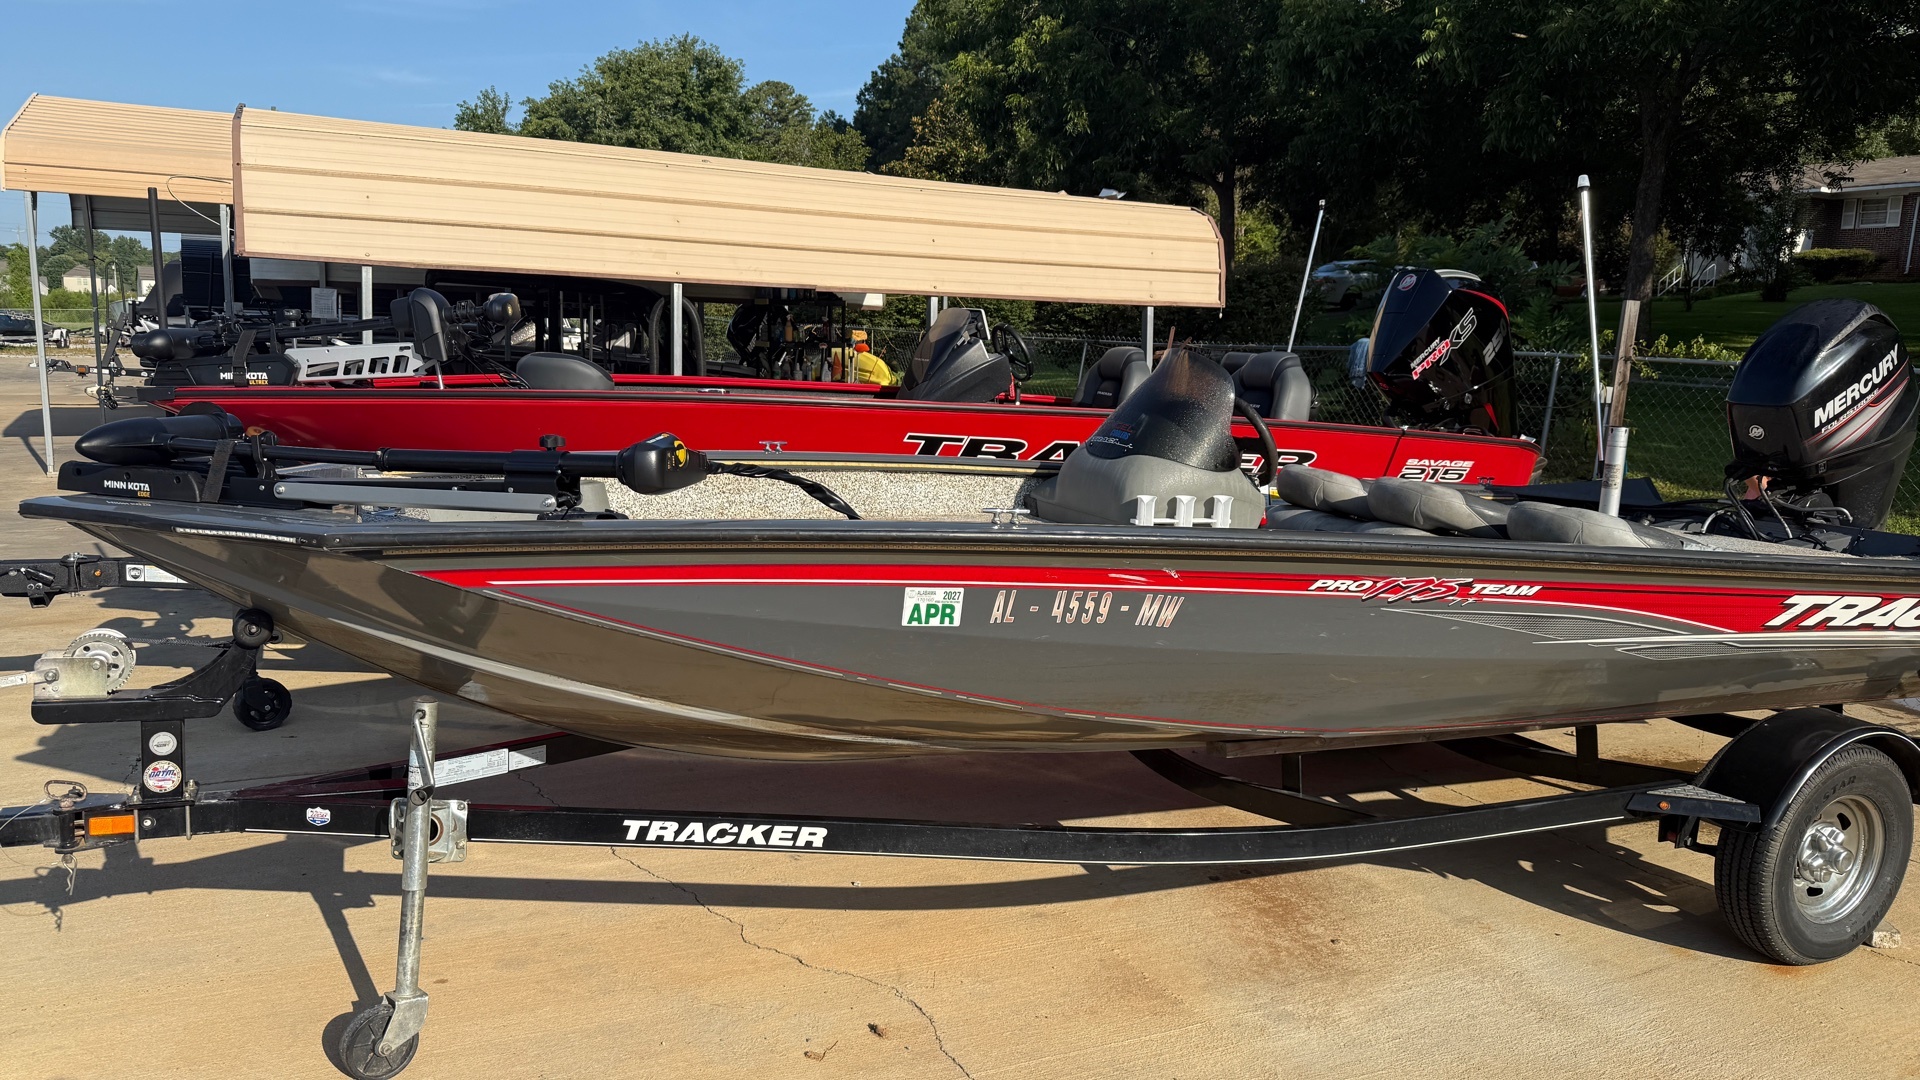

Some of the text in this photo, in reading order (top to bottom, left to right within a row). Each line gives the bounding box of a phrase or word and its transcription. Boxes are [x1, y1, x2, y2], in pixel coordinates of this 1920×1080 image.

[1410, 337, 1440, 369] MERCURY
[245, 372, 269, 380] KOTA
[1814, 343, 1899, 428] MERCURY
[1821, 387, 1880, 434] FOURSTROKE
[903, 432, 1318, 470] TRAR
[1405, 458, 1475, 467] SAVAGE
[104, 480, 150, 491] MINN KOTA
[1397, 466, 1470, 482] 215
[137, 490, 151, 498] EDGE
[943, 591, 962, 601] 2027
[1308, 577, 1543, 602] PRO 175 TEAM
[907, 603, 956, 625] APR
[989, 589, 1017, 624] AL
[1051, 590, 1113, 624] 4559
[1135, 594, 1185, 628] MW
[623, 819, 829, 848] TRACKER
